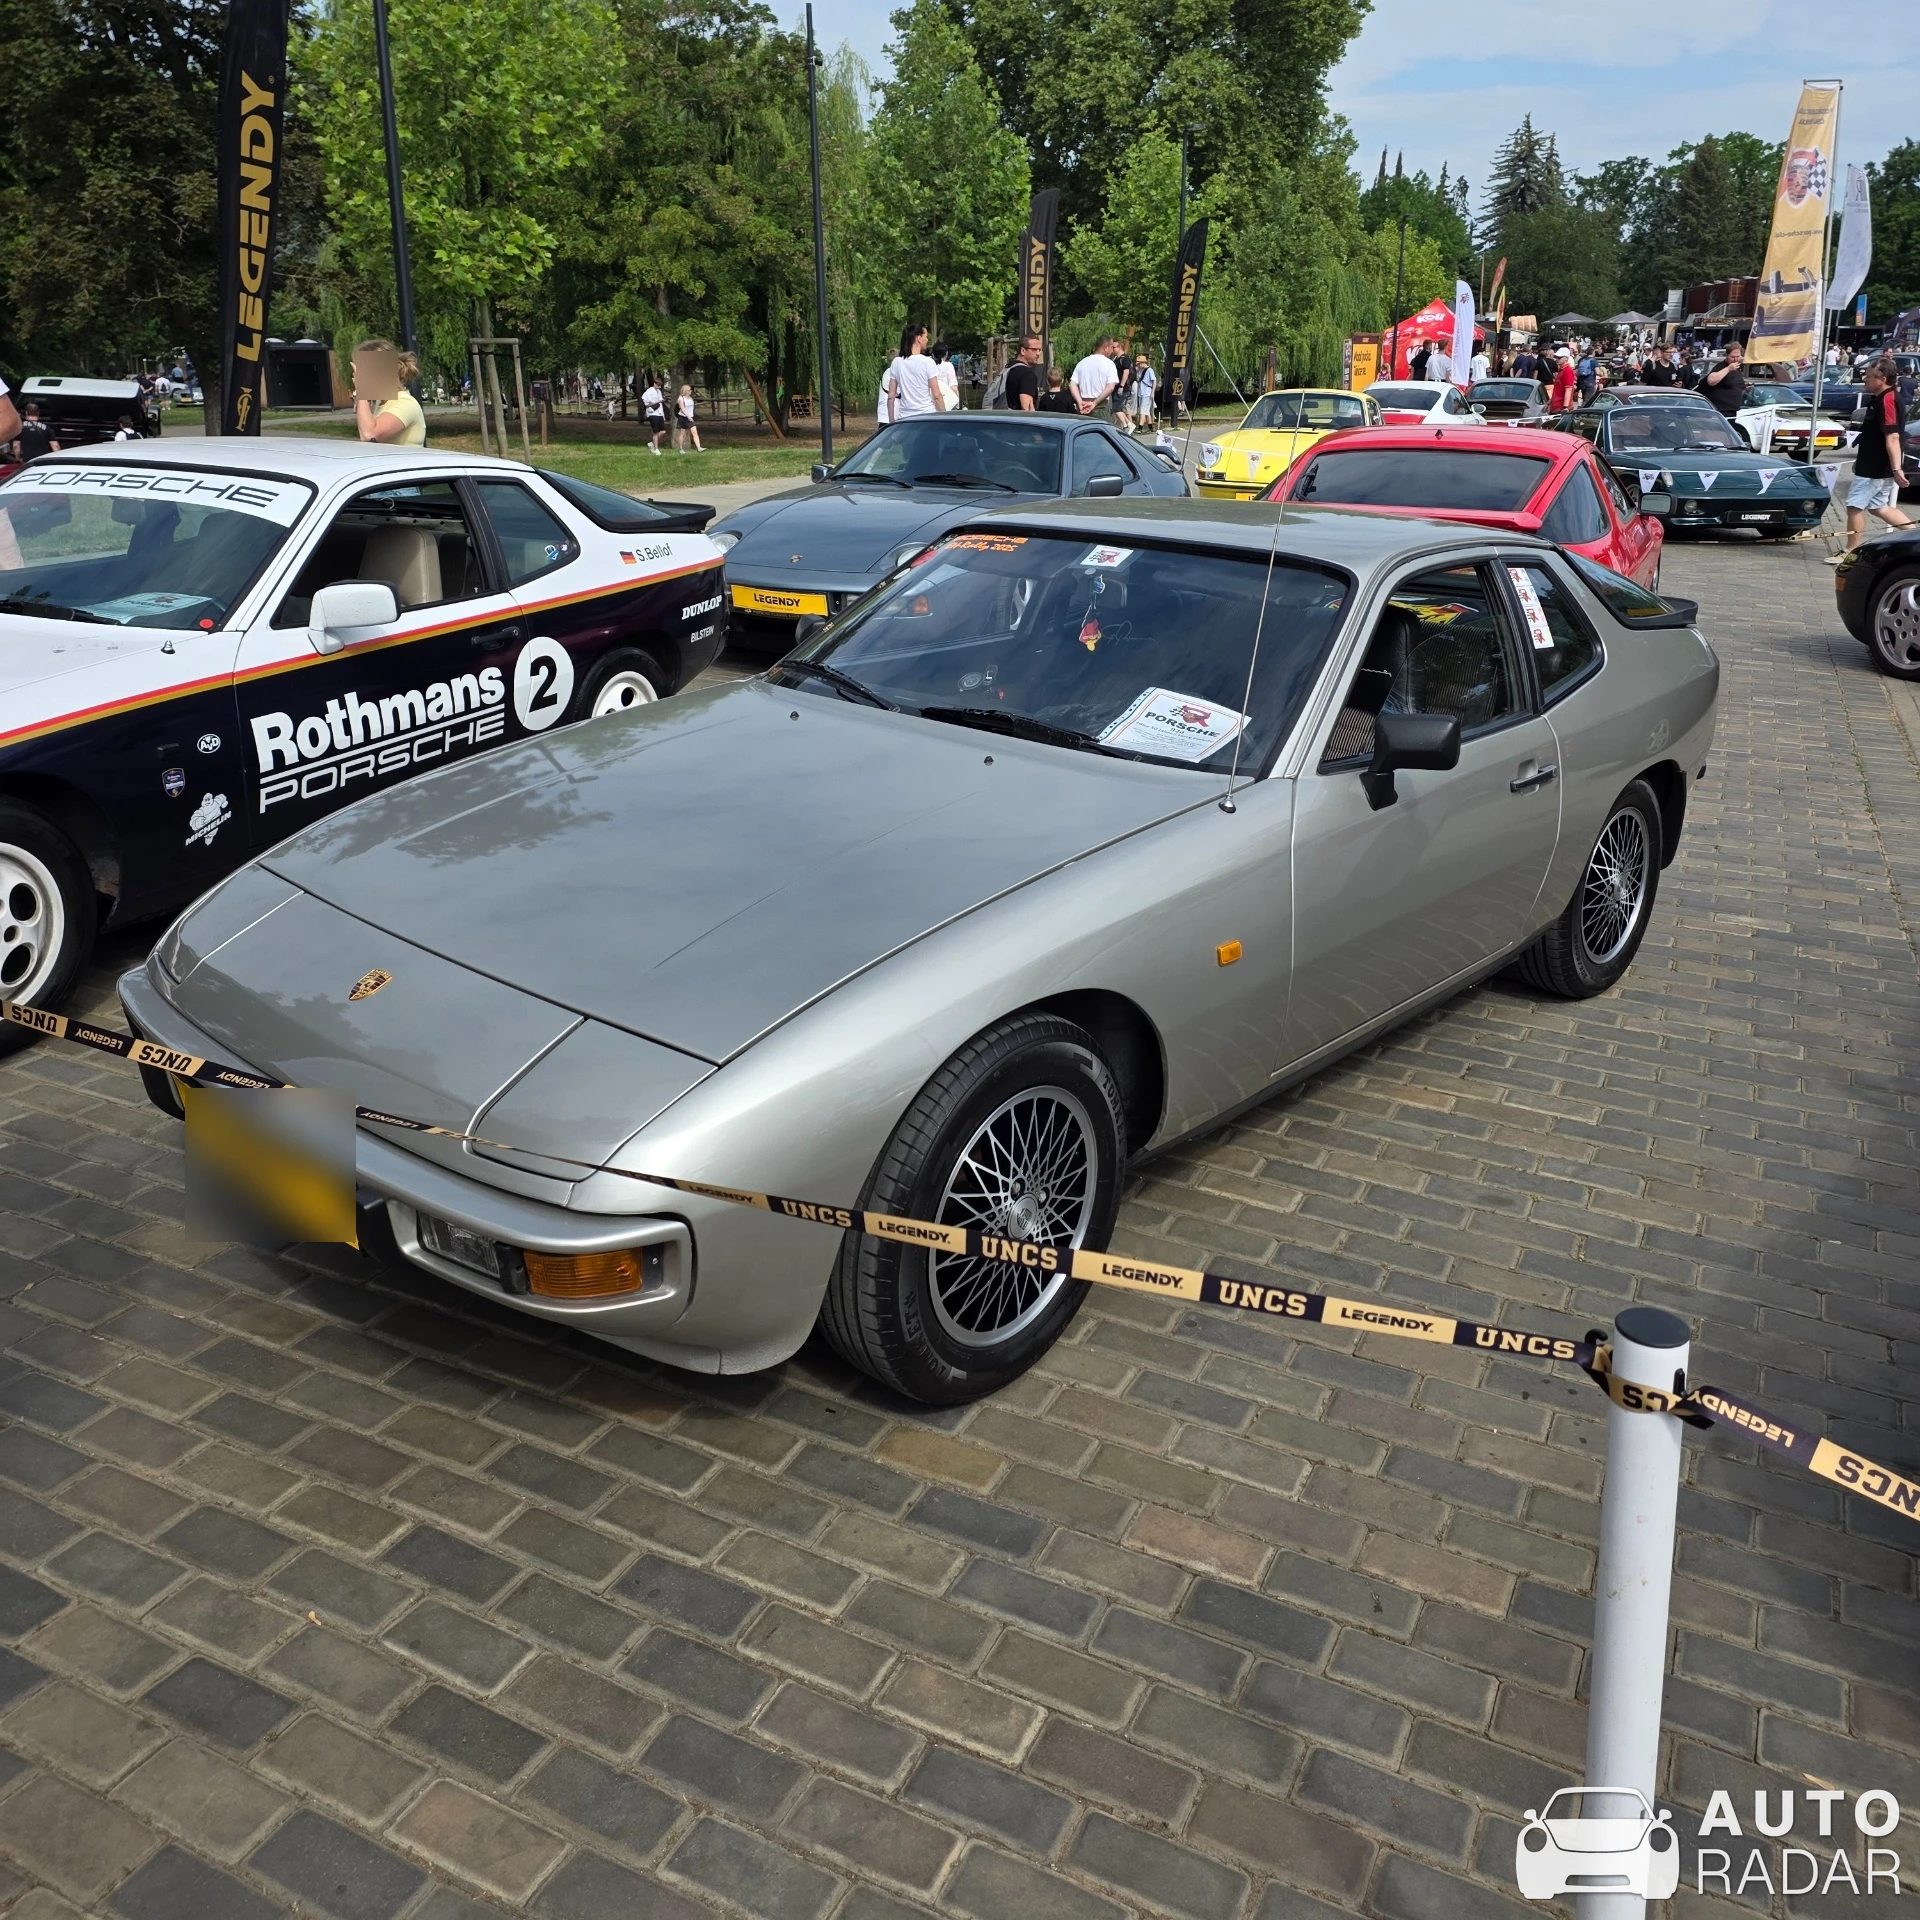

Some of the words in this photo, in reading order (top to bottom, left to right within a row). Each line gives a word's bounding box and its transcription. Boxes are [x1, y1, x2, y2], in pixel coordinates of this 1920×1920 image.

[237, 70, 275, 362] LEGENDY
[1172, 262, 1198, 368] LEGENDY
[5, 471, 280, 508] PORSCHE
[635, 543, 673, 562] S.Bellof
[681, 594, 722, 620] DUNLOP
[753, 593, 801, 607] LEGENDY
[690, 625, 715, 643] BILSTEIN
[529, 655, 558, 713] 2
[250, 666, 506, 773] Rothmans
[1144, 711, 1221, 738] PORSCHE
[259, 711, 506, 815] PORSCHE
[185, 810, 232, 846] MICHELIN
[12, 1005, 58, 1033] UNCS
[75, 1027, 124, 1050] LEGENDY
[138, 1045, 193, 1073] UNCS
[360, 1111, 420, 1129] LEGENDY
[688, 1184, 756, 1204] LEGENDY
[781, 1200, 853, 1228] UNCS
[878, 1220, 952, 1245] LEGENDY
[981, 1235, 1058, 1270] UNCS
[1101, 1262, 1184, 1290] LEGENDY
[1218, 1280, 1309, 1317] UNCS
[1340, 1307, 1434, 1333] LEGENDY
[1474, 1325, 1576, 1360] UNCS
[1687, 1389, 1795, 1448] LEGENDY
[1834, 1454, 1920, 1516] NCS
